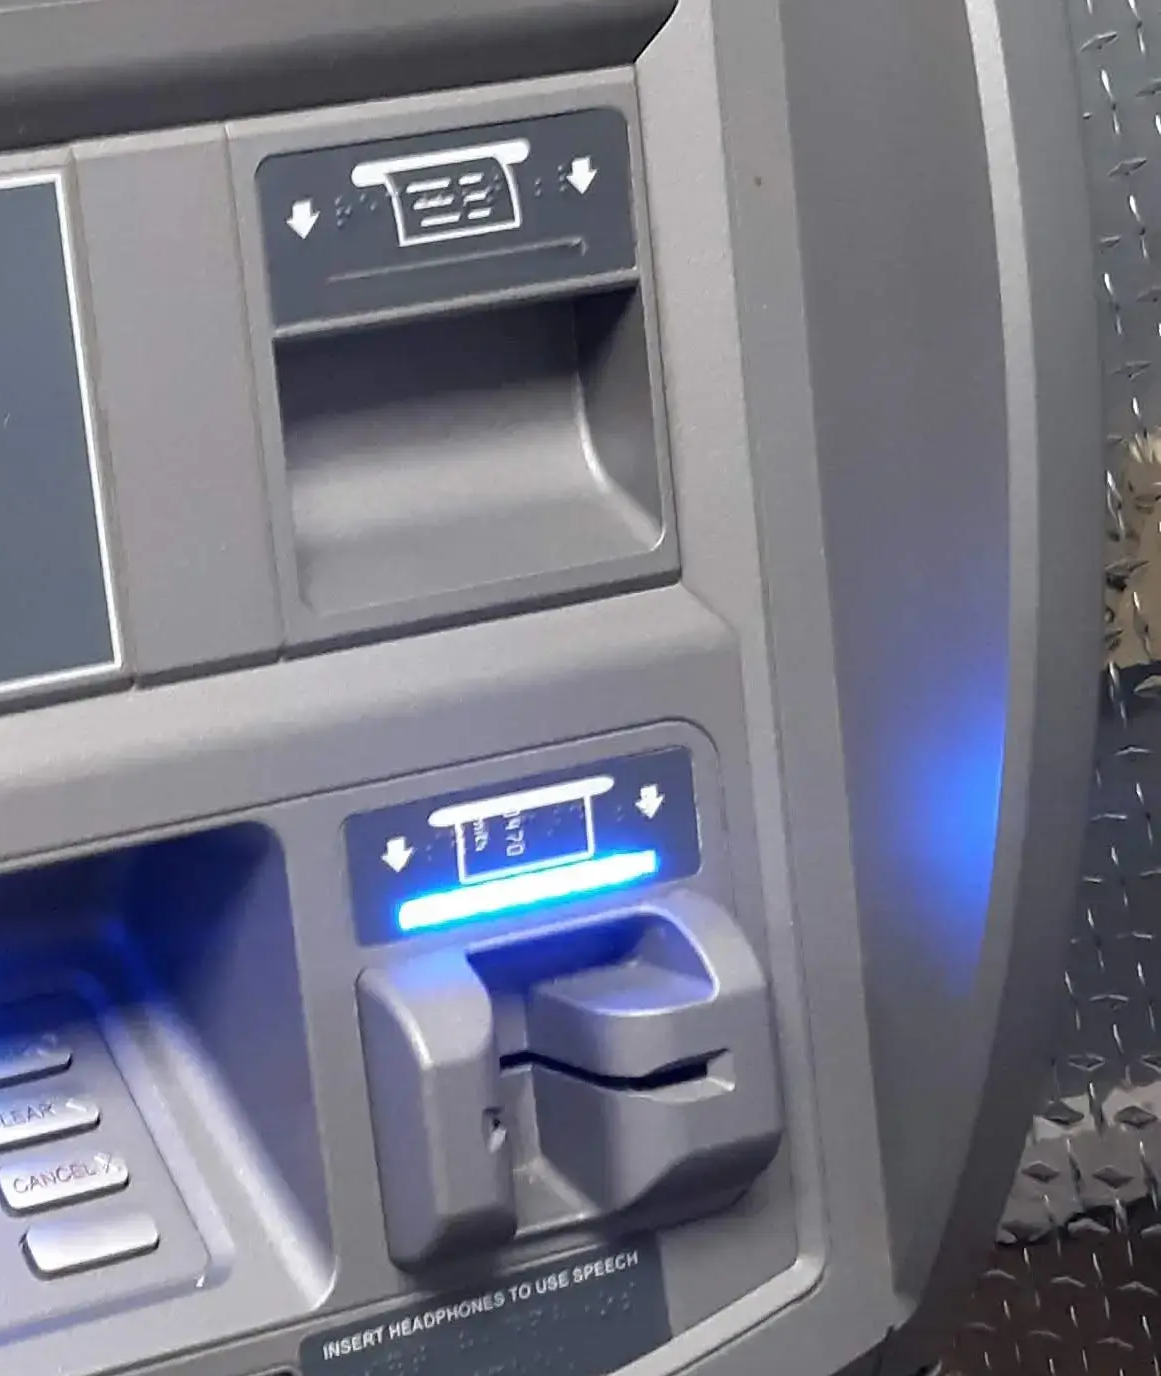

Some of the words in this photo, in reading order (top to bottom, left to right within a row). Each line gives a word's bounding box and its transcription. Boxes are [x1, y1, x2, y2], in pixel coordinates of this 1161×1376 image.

[13, 1162, 96, 1193] CANCEL
[323, 1325, 385, 1360] INSERT
[389, 1289, 505, 1338] HEADPHONES
[508, 1283, 532, 1305] TO
[535, 1271, 570, 1295] USE
[572, 1250, 639, 1284] SPEECH
